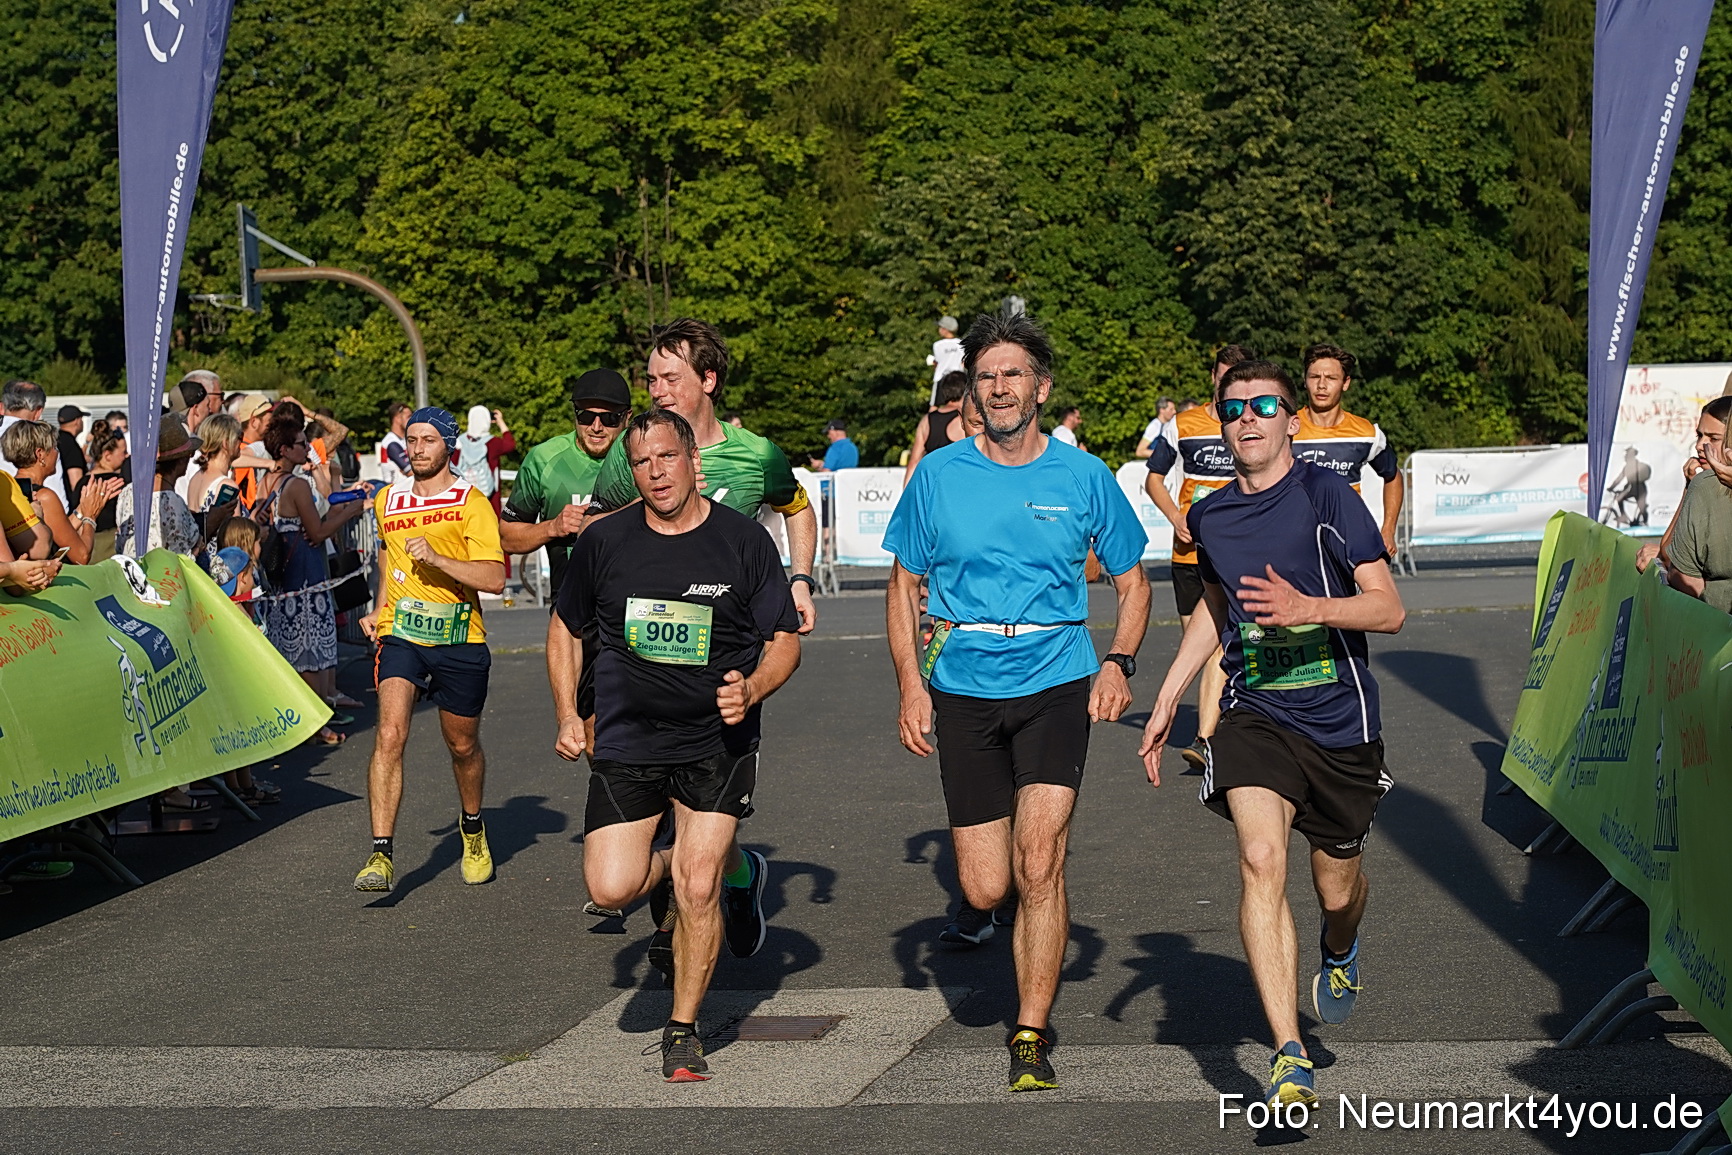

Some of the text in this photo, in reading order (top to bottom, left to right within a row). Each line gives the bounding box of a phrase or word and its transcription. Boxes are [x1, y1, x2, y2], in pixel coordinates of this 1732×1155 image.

[1607, 45, 1689, 362] www.fischer-automobile.de
[1436, 473, 1470, 486] NOW
[858, 489, 892, 502] NOW
[383, 511, 463, 534] MAX BÖGL
[404, 612, 445, 631] 1610
[646, 621, 689, 644] 908
[629, 626, 638, 647] RUN
[697, 628, 707, 657] 2022
[637, 642, 697, 655] Ziegaus Jürgen
[1263, 646, 1307, 669] 961
[1319, 645, 1331, 675] 2022
[1248, 652, 1259, 676] RUN
[1294, 666, 1321, 677] Julian
